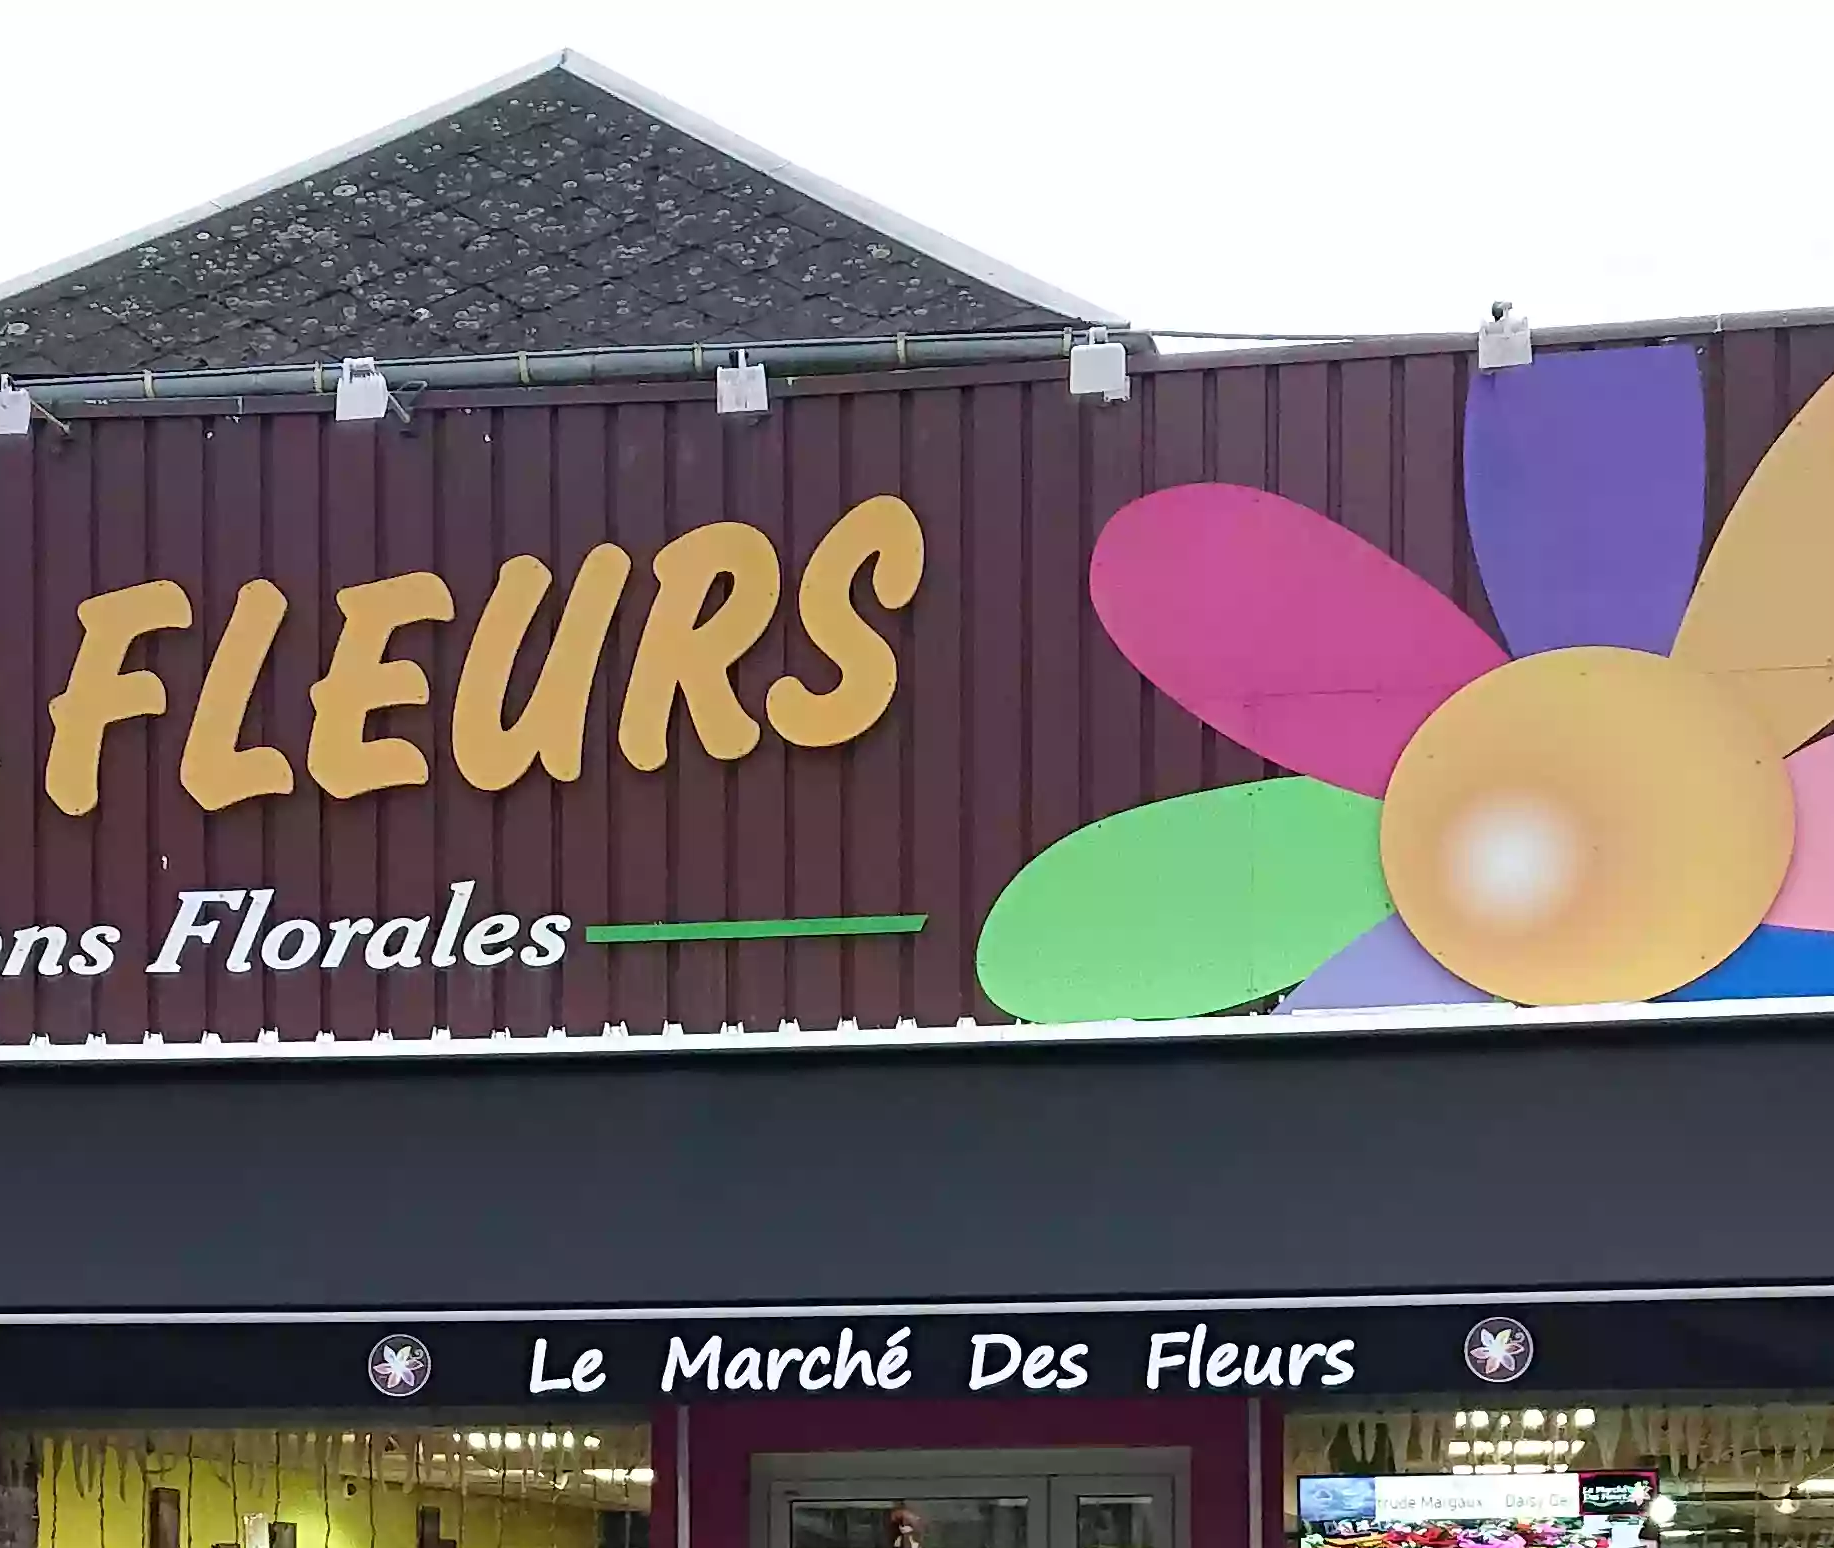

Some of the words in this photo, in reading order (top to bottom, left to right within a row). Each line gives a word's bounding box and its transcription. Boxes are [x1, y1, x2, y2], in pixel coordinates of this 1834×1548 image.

[44, 493, 927, 819] FLEURS
[145, 878, 574, 977] Florales
[527, 1337, 608, 1396] Le
[659, 1326, 914, 1393] Marché
[967, 1332, 1091, 1391] Des
[1144, 1325, 1357, 1390] Fleurs
